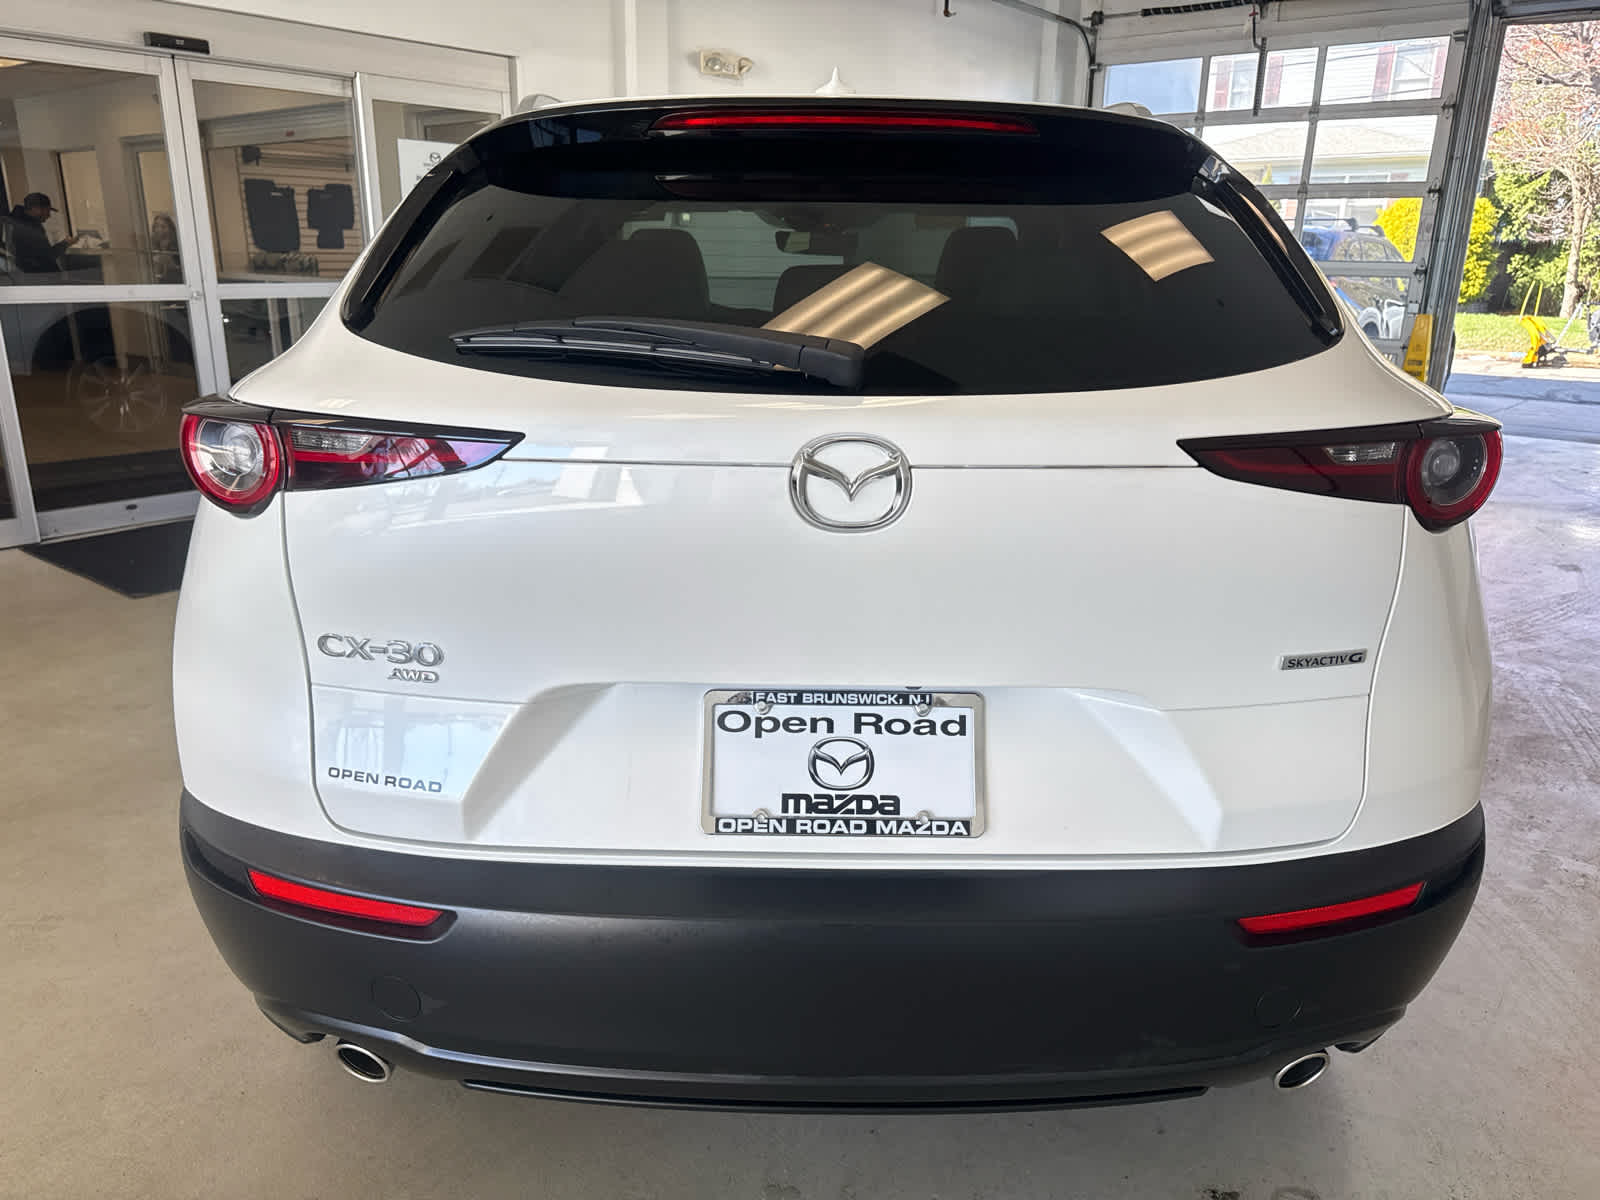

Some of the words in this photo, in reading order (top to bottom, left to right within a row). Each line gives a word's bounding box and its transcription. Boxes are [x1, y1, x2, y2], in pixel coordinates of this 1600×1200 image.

[317, 633, 445, 667] CX-30
[387, 668, 440, 683] AWD
[754, 692, 797, 704] EAST
[802, 693, 903, 705] BRUNSWICK,
[717, 710, 834, 738] Open
[854, 713, 967, 736] Road
[328, 767, 379, 784] OPEN
[384, 776, 442, 793] ROAD
[718, 818, 786, 833] OPEN
[796, 820, 866, 835] ROAD
[876, 821, 968, 836] MAZDA
